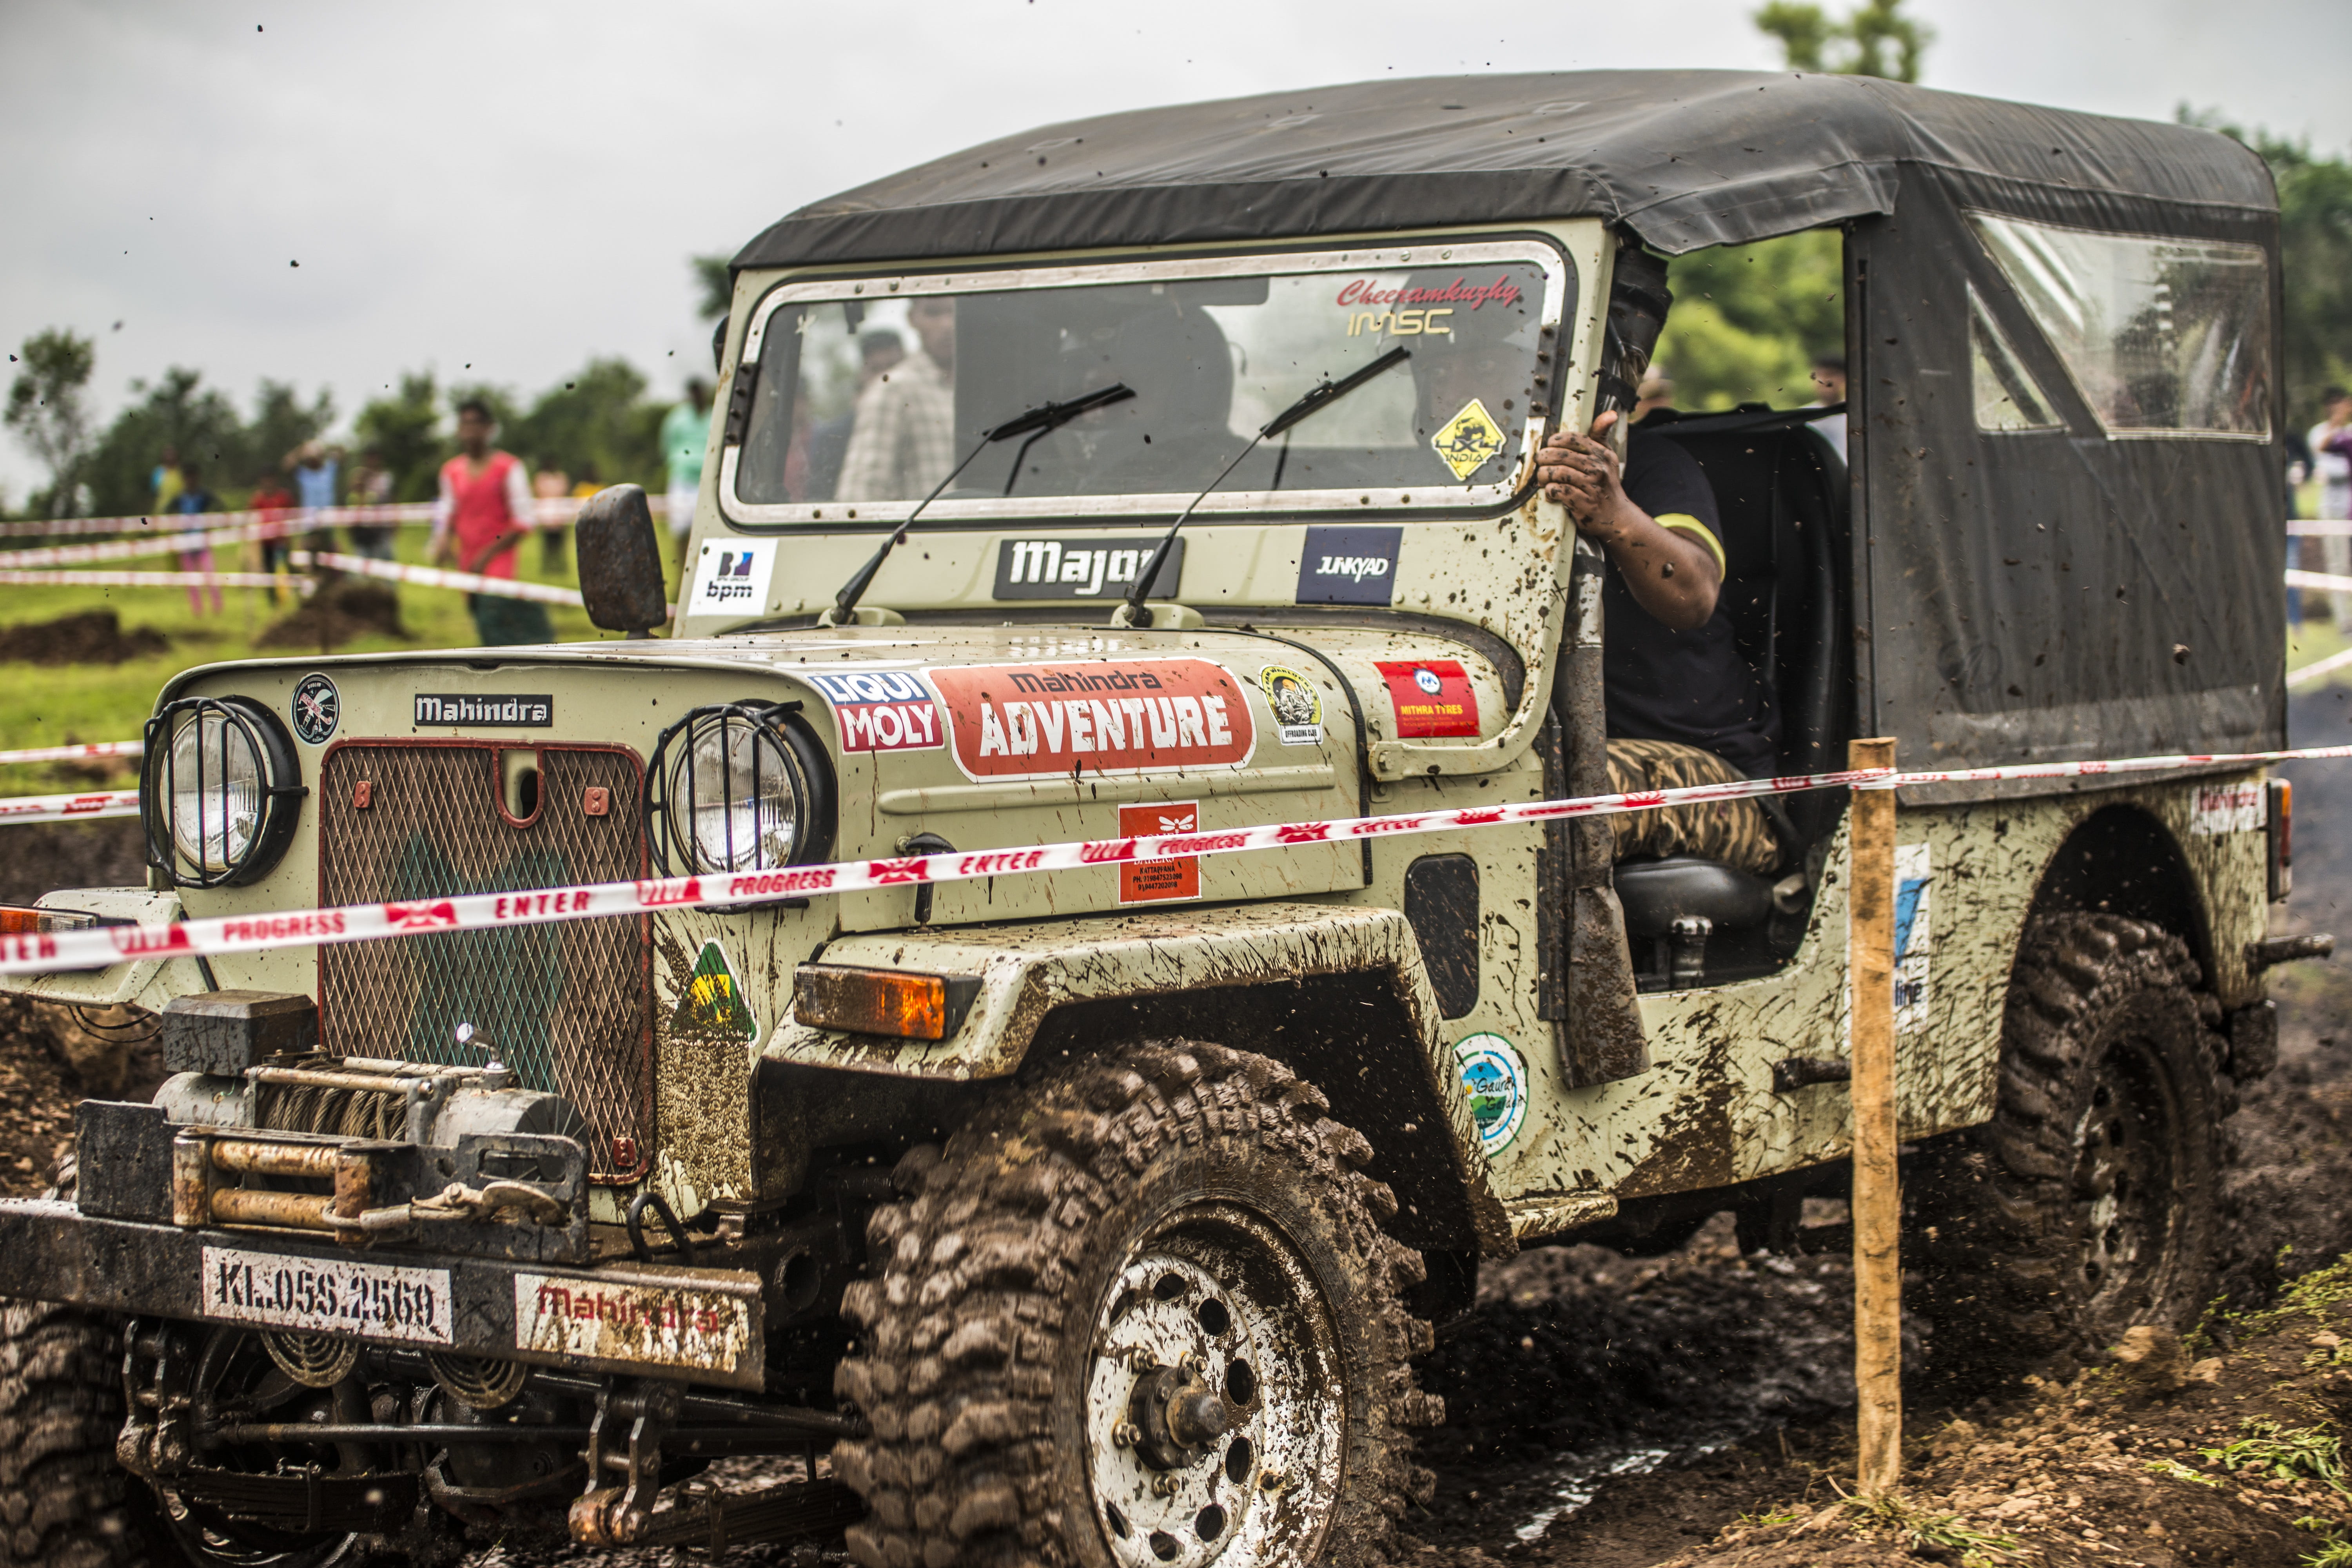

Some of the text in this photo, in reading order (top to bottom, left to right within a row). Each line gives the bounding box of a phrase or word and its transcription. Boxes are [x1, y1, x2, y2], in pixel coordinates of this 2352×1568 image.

[1337, 274, 1520, 310] Cheeramkuzhy
[1446, 454, 1483, 462] INDIA
[706, 581, 752, 601] bpm
[814, 672, 925, 702] LIQUI
[1008, 670, 1163, 693] Mahindra
[416, 698, 547, 721] Mahindra
[1401, 705, 1463, 714] MITHRA TYRES
[841, 704, 933, 747] MOLY
[980, 695, 1232, 757] ADVENTURE
[223, 912, 345, 942] PROGRESS
[494, 891, 592, 919] ENTER
[729, 869, 836, 896] PROGRESS
[960, 850, 1044, 875] ENTER
